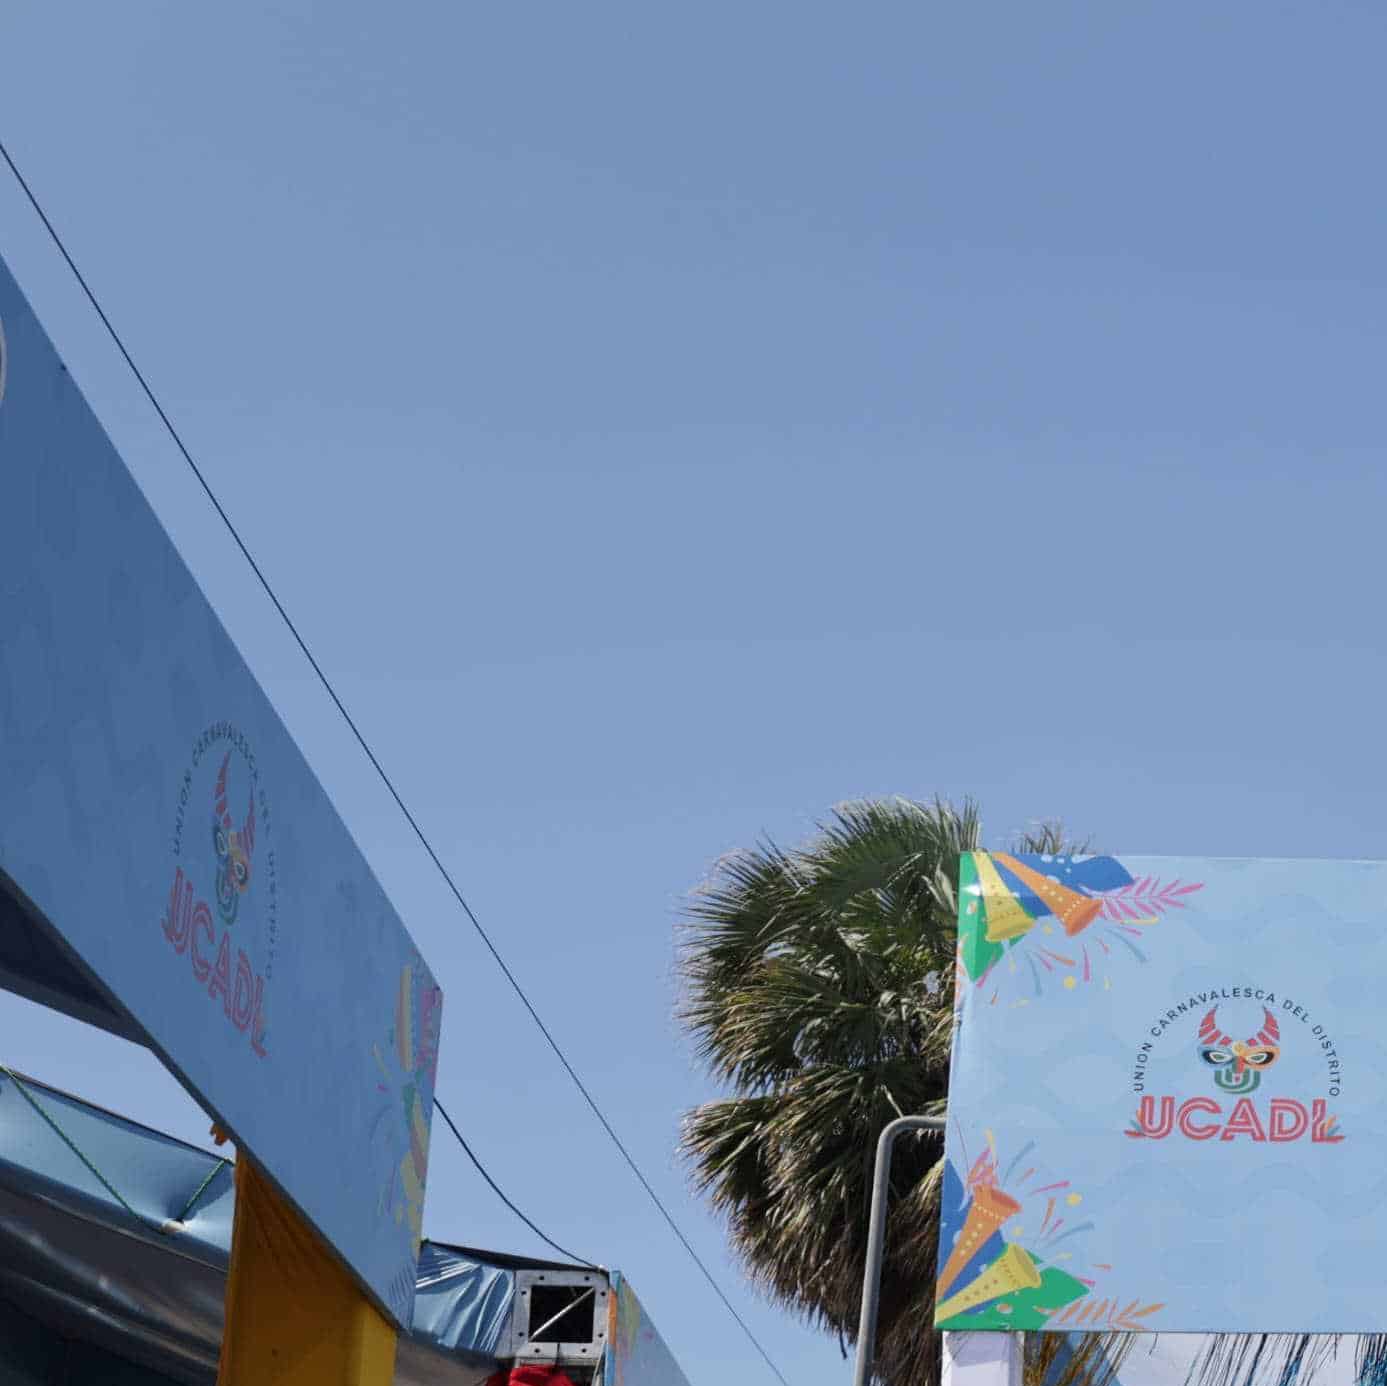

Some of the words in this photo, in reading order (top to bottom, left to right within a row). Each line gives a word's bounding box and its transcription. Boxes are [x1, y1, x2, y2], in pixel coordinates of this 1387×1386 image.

[1133, 1042, 1153, 1092] UNION
[1150, 987, 1276, 1038] CARNAVALESCA
[1282, 999, 1309, 1024] DEL
[1311, 1024, 1341, 1097] DISTRITO
